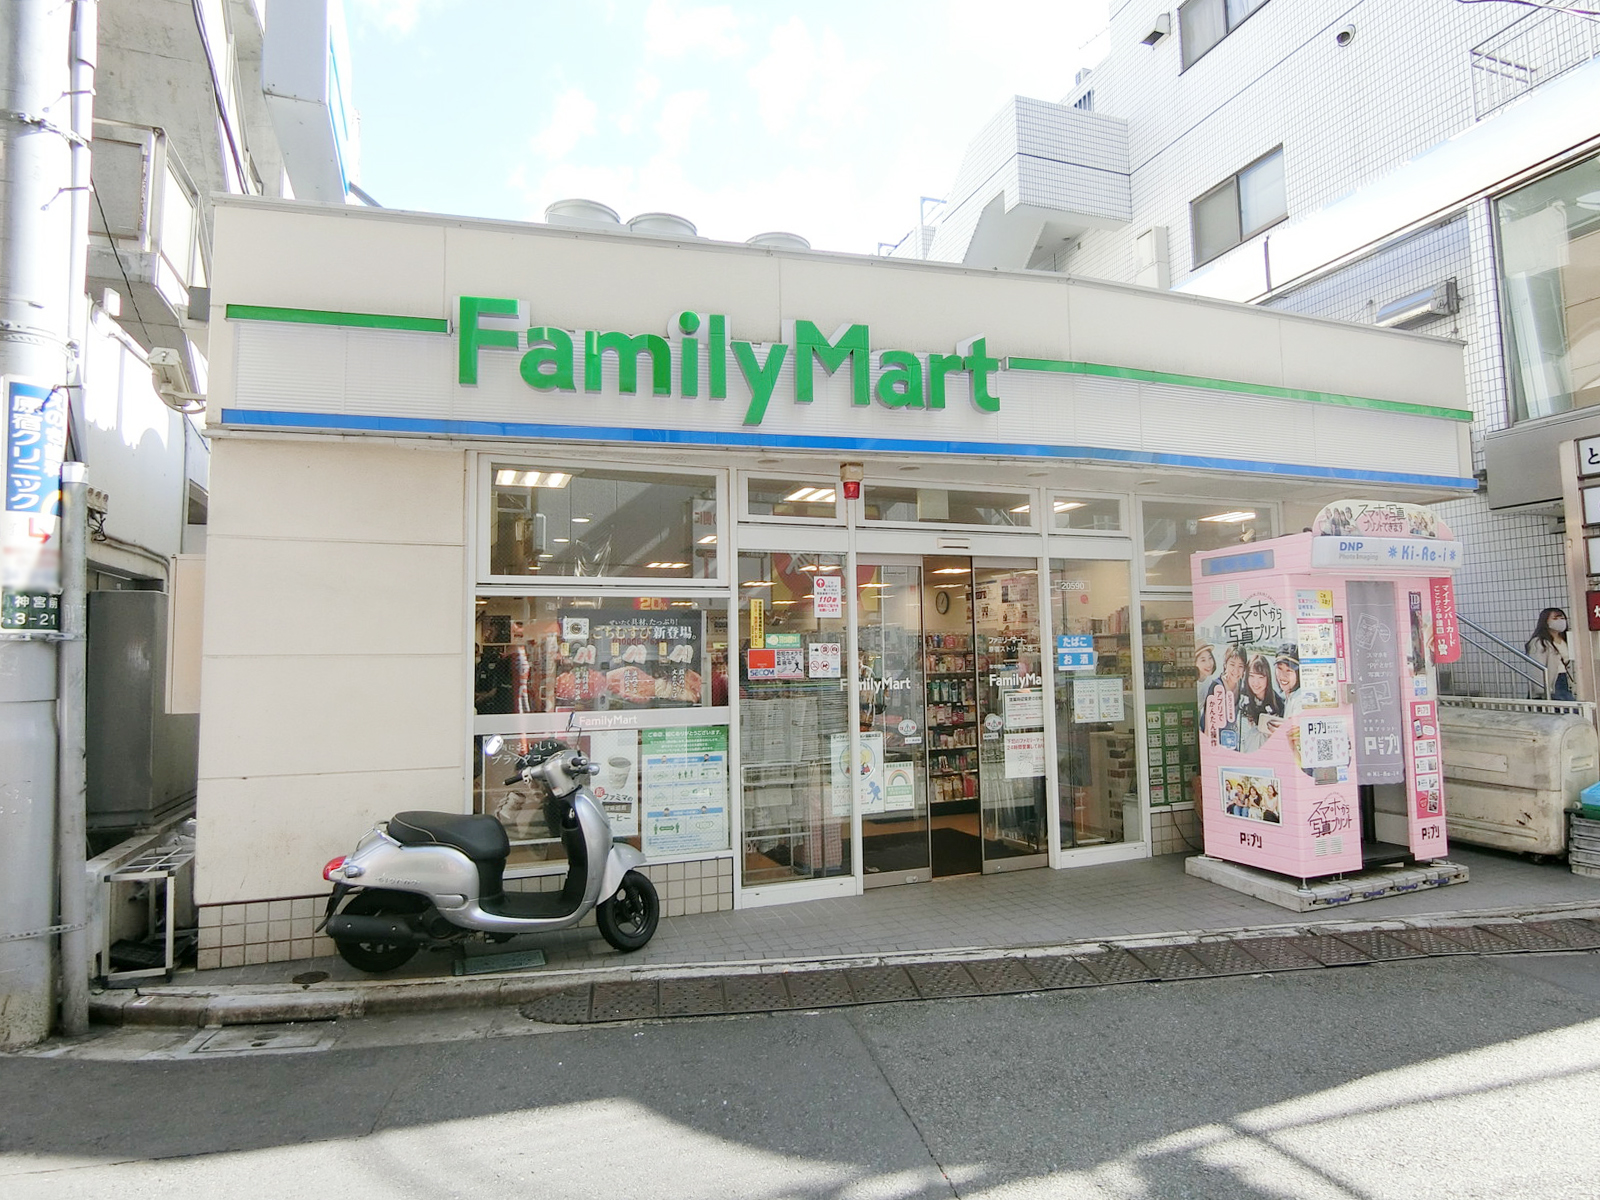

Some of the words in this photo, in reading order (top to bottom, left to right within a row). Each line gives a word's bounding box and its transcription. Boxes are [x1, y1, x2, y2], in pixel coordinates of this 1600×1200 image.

[459, 296, 1001, 426] FamilyMart
[10, 395, 44, 509] 原宿クリニック
[1339, 541, 1363, 551] DNP
[1356, 553, 1378, 561] Imaging
[1061, 582, 1085, 590] 20590
[14, 595, 58, 609] 神宮前
[14, 612, 56, 626] 3-21
[1221, 600, 1282, 628] スマホから
[1441, 585, 1455, 647] マイナンバーカード
[1224, 621, 1286, 646] 写真プリント
[1062, 637, 1088, 647] たばこ
[750, 669, 775, 677] SECOM
[579, 714, 638, 727] FamilyMart
[1307, 798, 1350, 822] スマホから
[1310, 814, 1352, 838] 写真プリント
